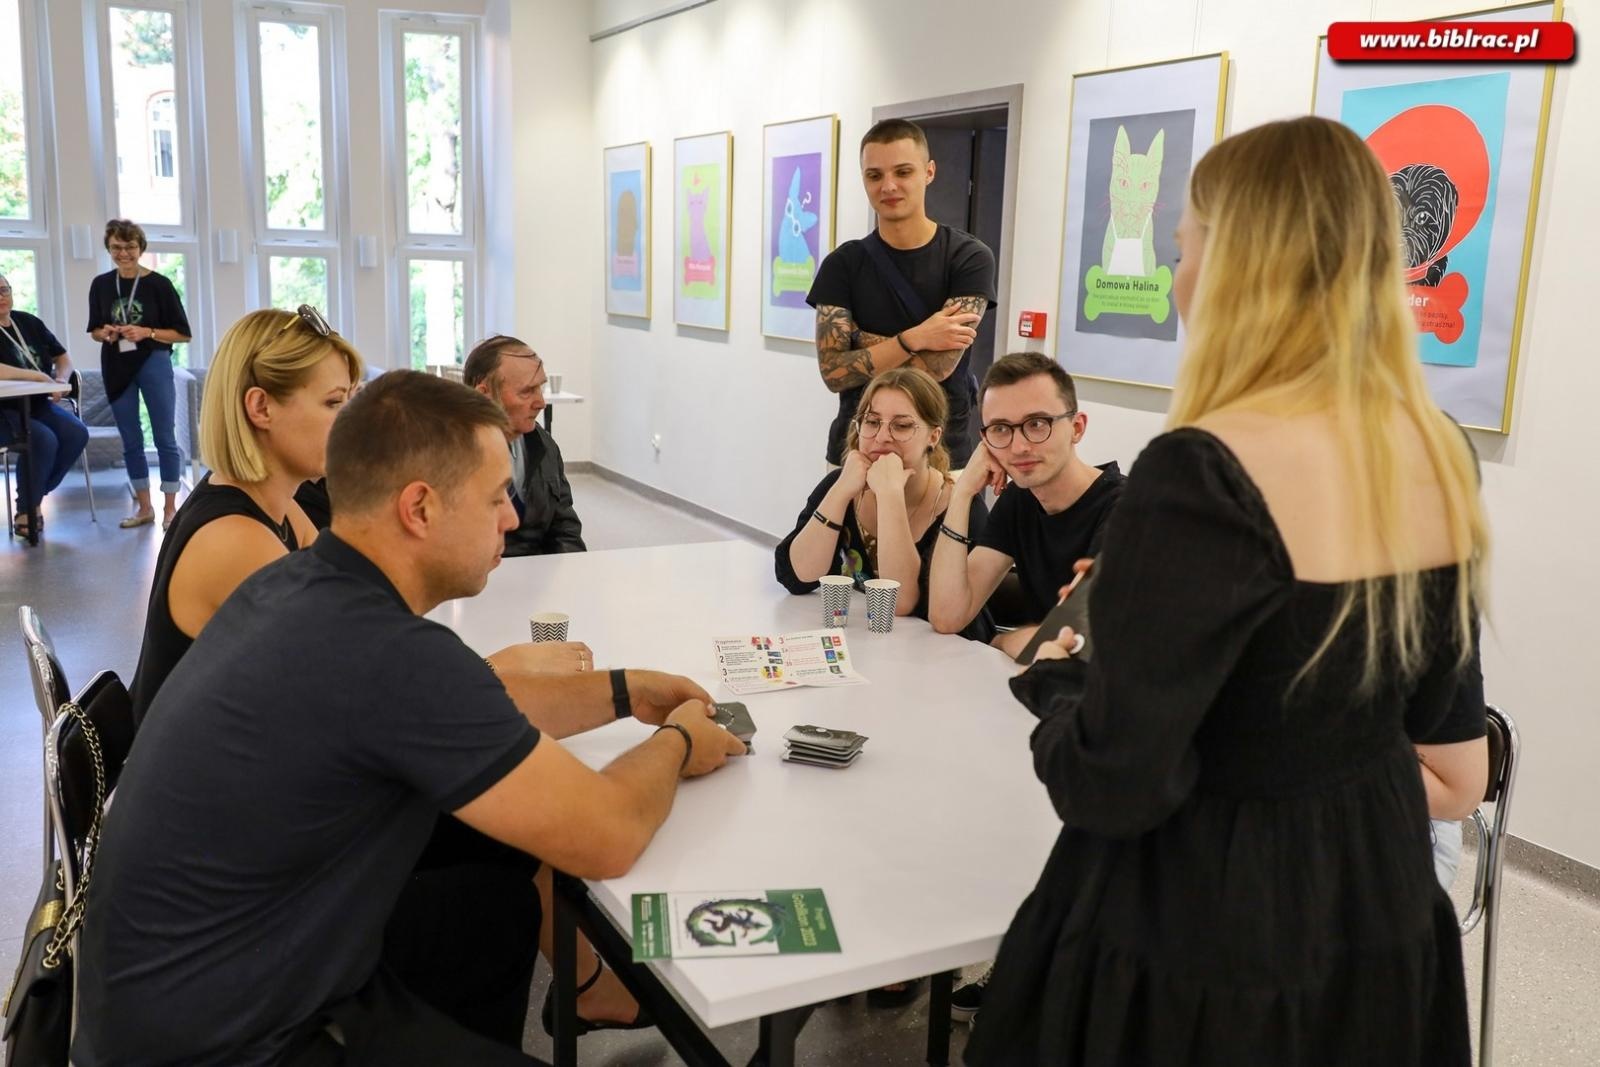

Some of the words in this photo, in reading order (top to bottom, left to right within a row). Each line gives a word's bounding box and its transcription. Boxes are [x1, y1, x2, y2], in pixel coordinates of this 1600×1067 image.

[1095, 278, 1130, 290] Domowa
[1132, 280, 1160, 292] Halina
[1408, 293, 1429, 307] der
[719, 655, 725, 664] 2
[722, 668, 728, 676] 3
